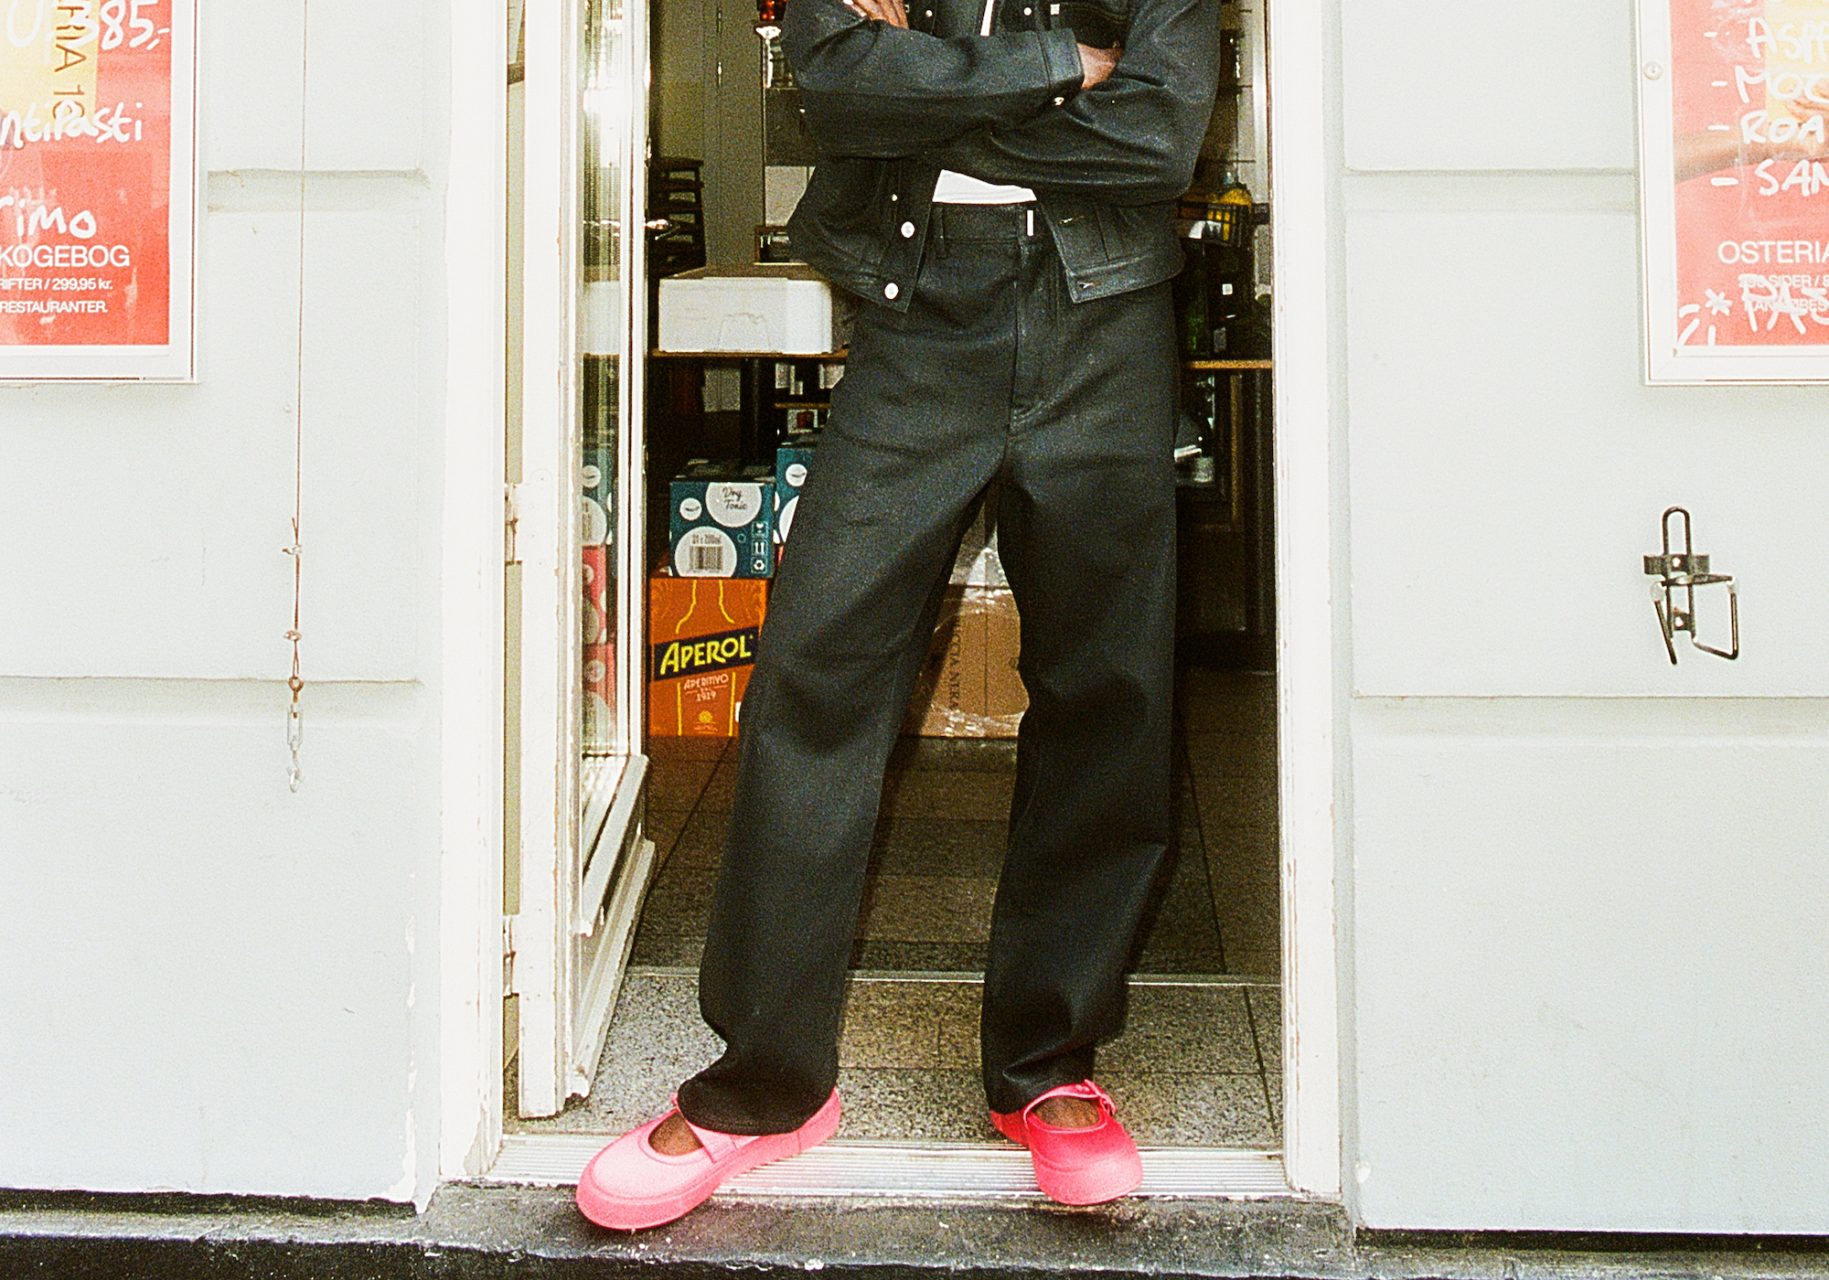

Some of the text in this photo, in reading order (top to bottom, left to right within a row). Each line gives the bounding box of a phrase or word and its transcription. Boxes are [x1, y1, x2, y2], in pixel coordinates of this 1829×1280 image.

[0, 244, 130, 268] KOGEBOG
[51, 277, 97, 292] 299,95
[660, 635, 752, 675] APEROL
[683, 673, 729, 691] APERITIVO
